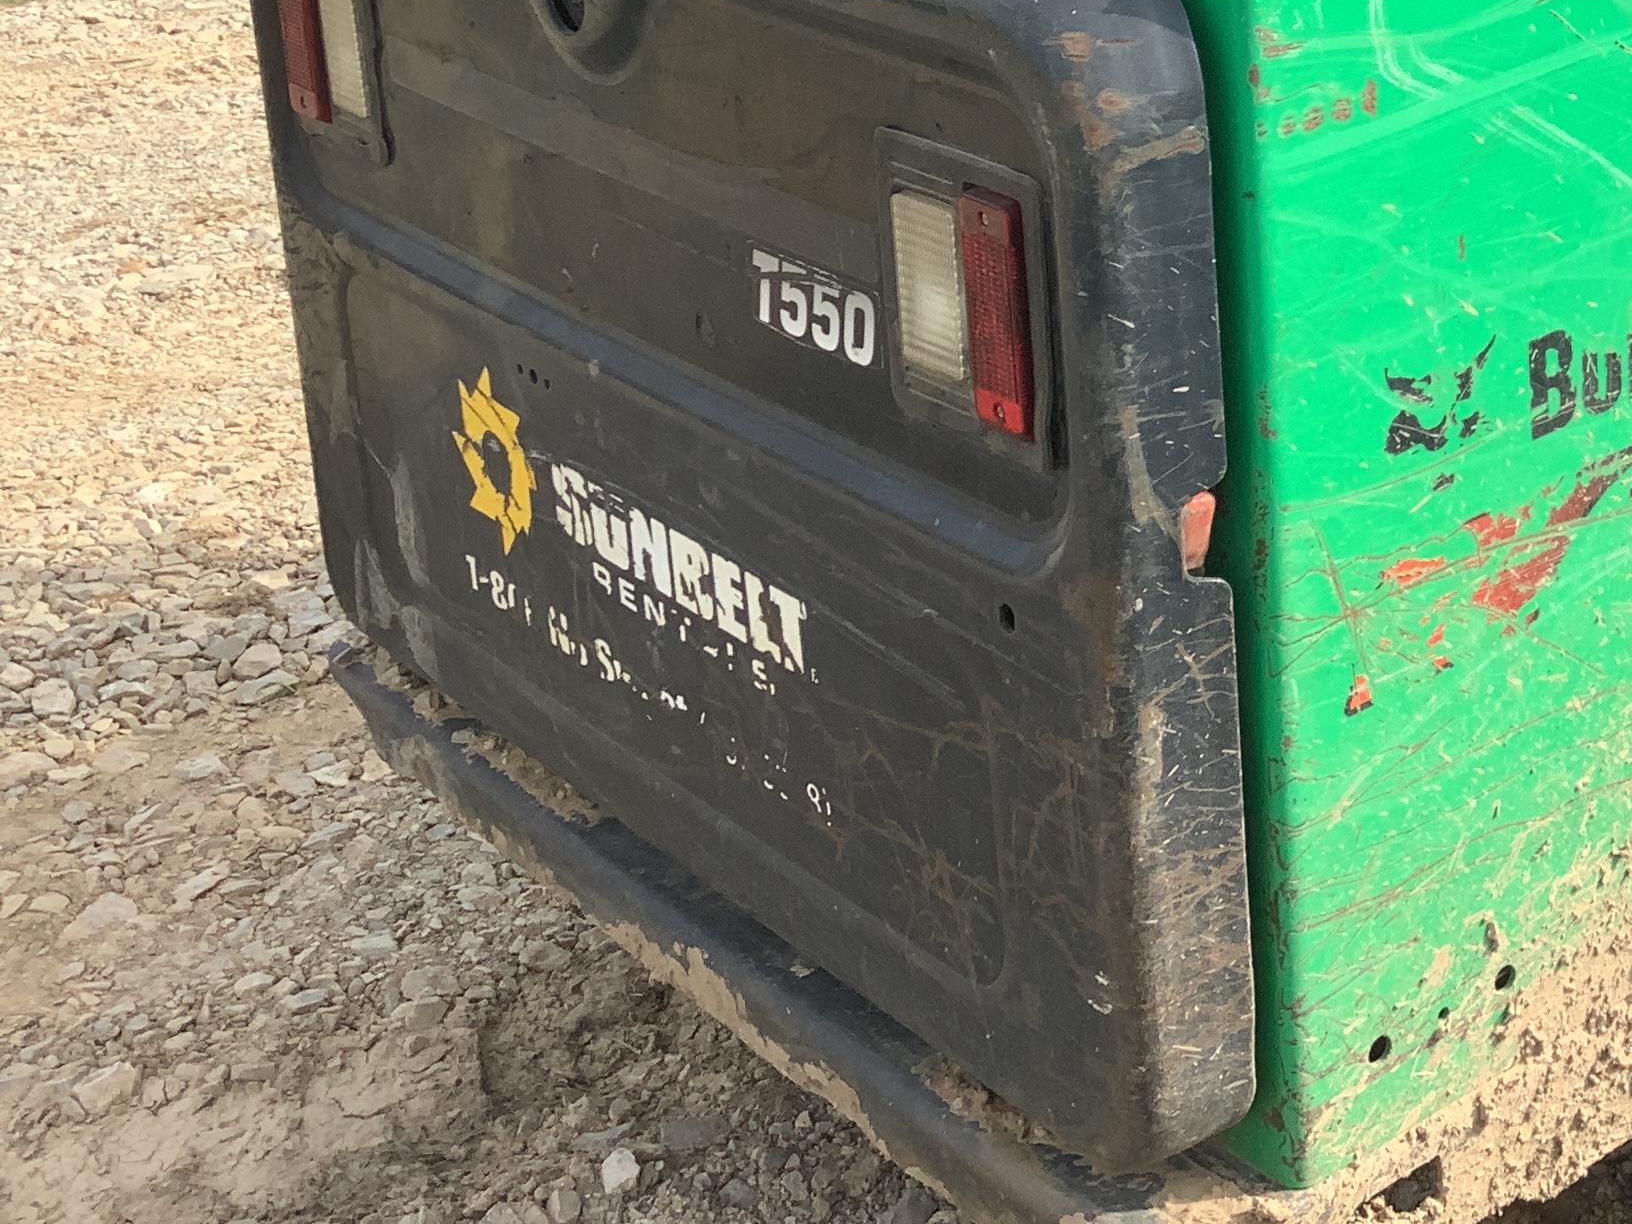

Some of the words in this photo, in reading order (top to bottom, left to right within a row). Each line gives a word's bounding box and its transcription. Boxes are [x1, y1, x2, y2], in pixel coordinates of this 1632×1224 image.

[752, 248, 876, 366] T550
[551, 462, 808, 674] SUNBELT
[591, 561, 776, 696] RENS
